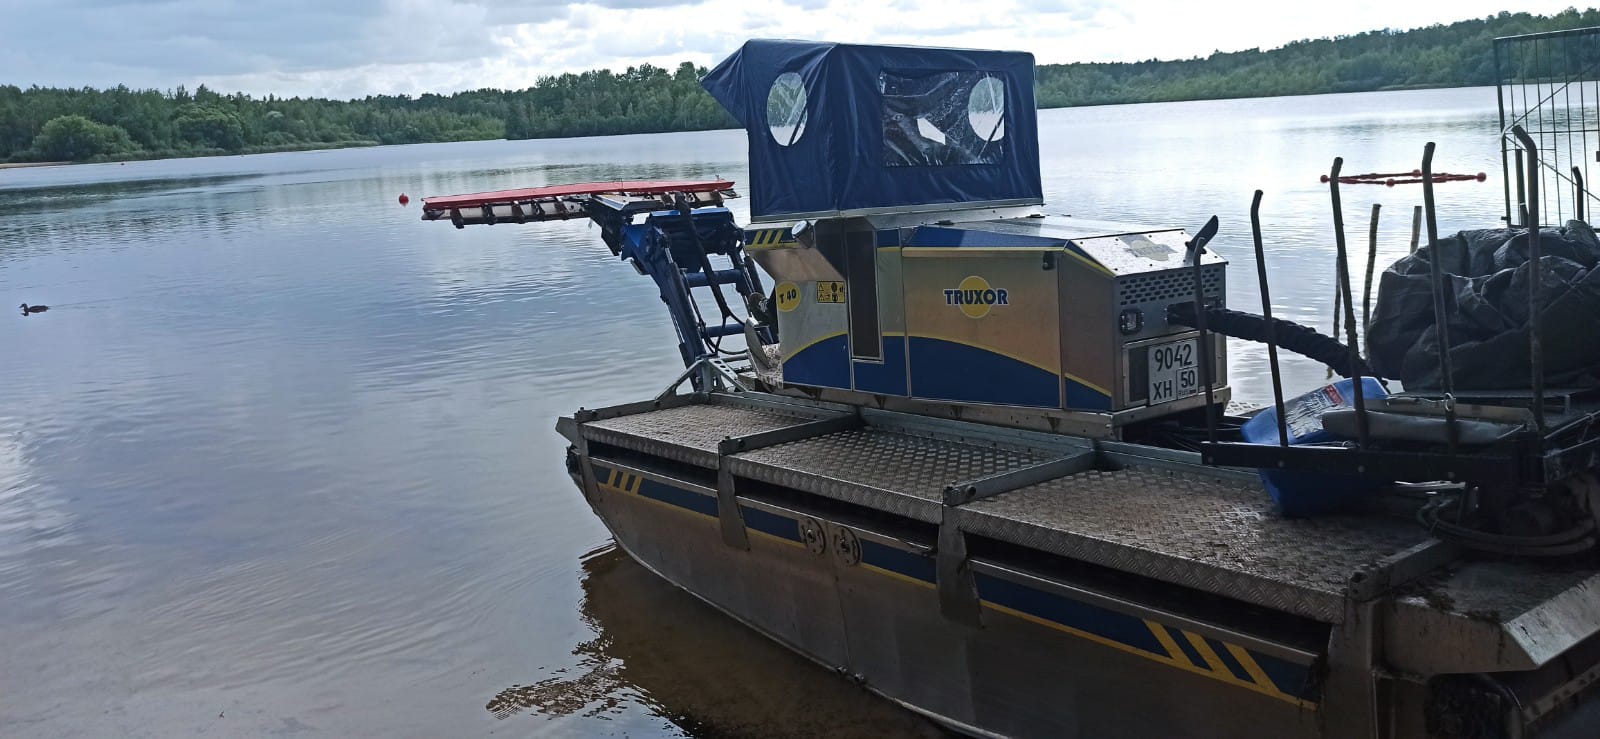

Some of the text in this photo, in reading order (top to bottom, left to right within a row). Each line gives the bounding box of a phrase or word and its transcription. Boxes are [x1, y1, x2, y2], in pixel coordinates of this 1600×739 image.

[779, 288, 797, 304] T 40
[943, 288, 1008, 305] TRUXOR
[1154, 343, 1193, 372] 9042
[1181, 370, 1196, 388] 50
